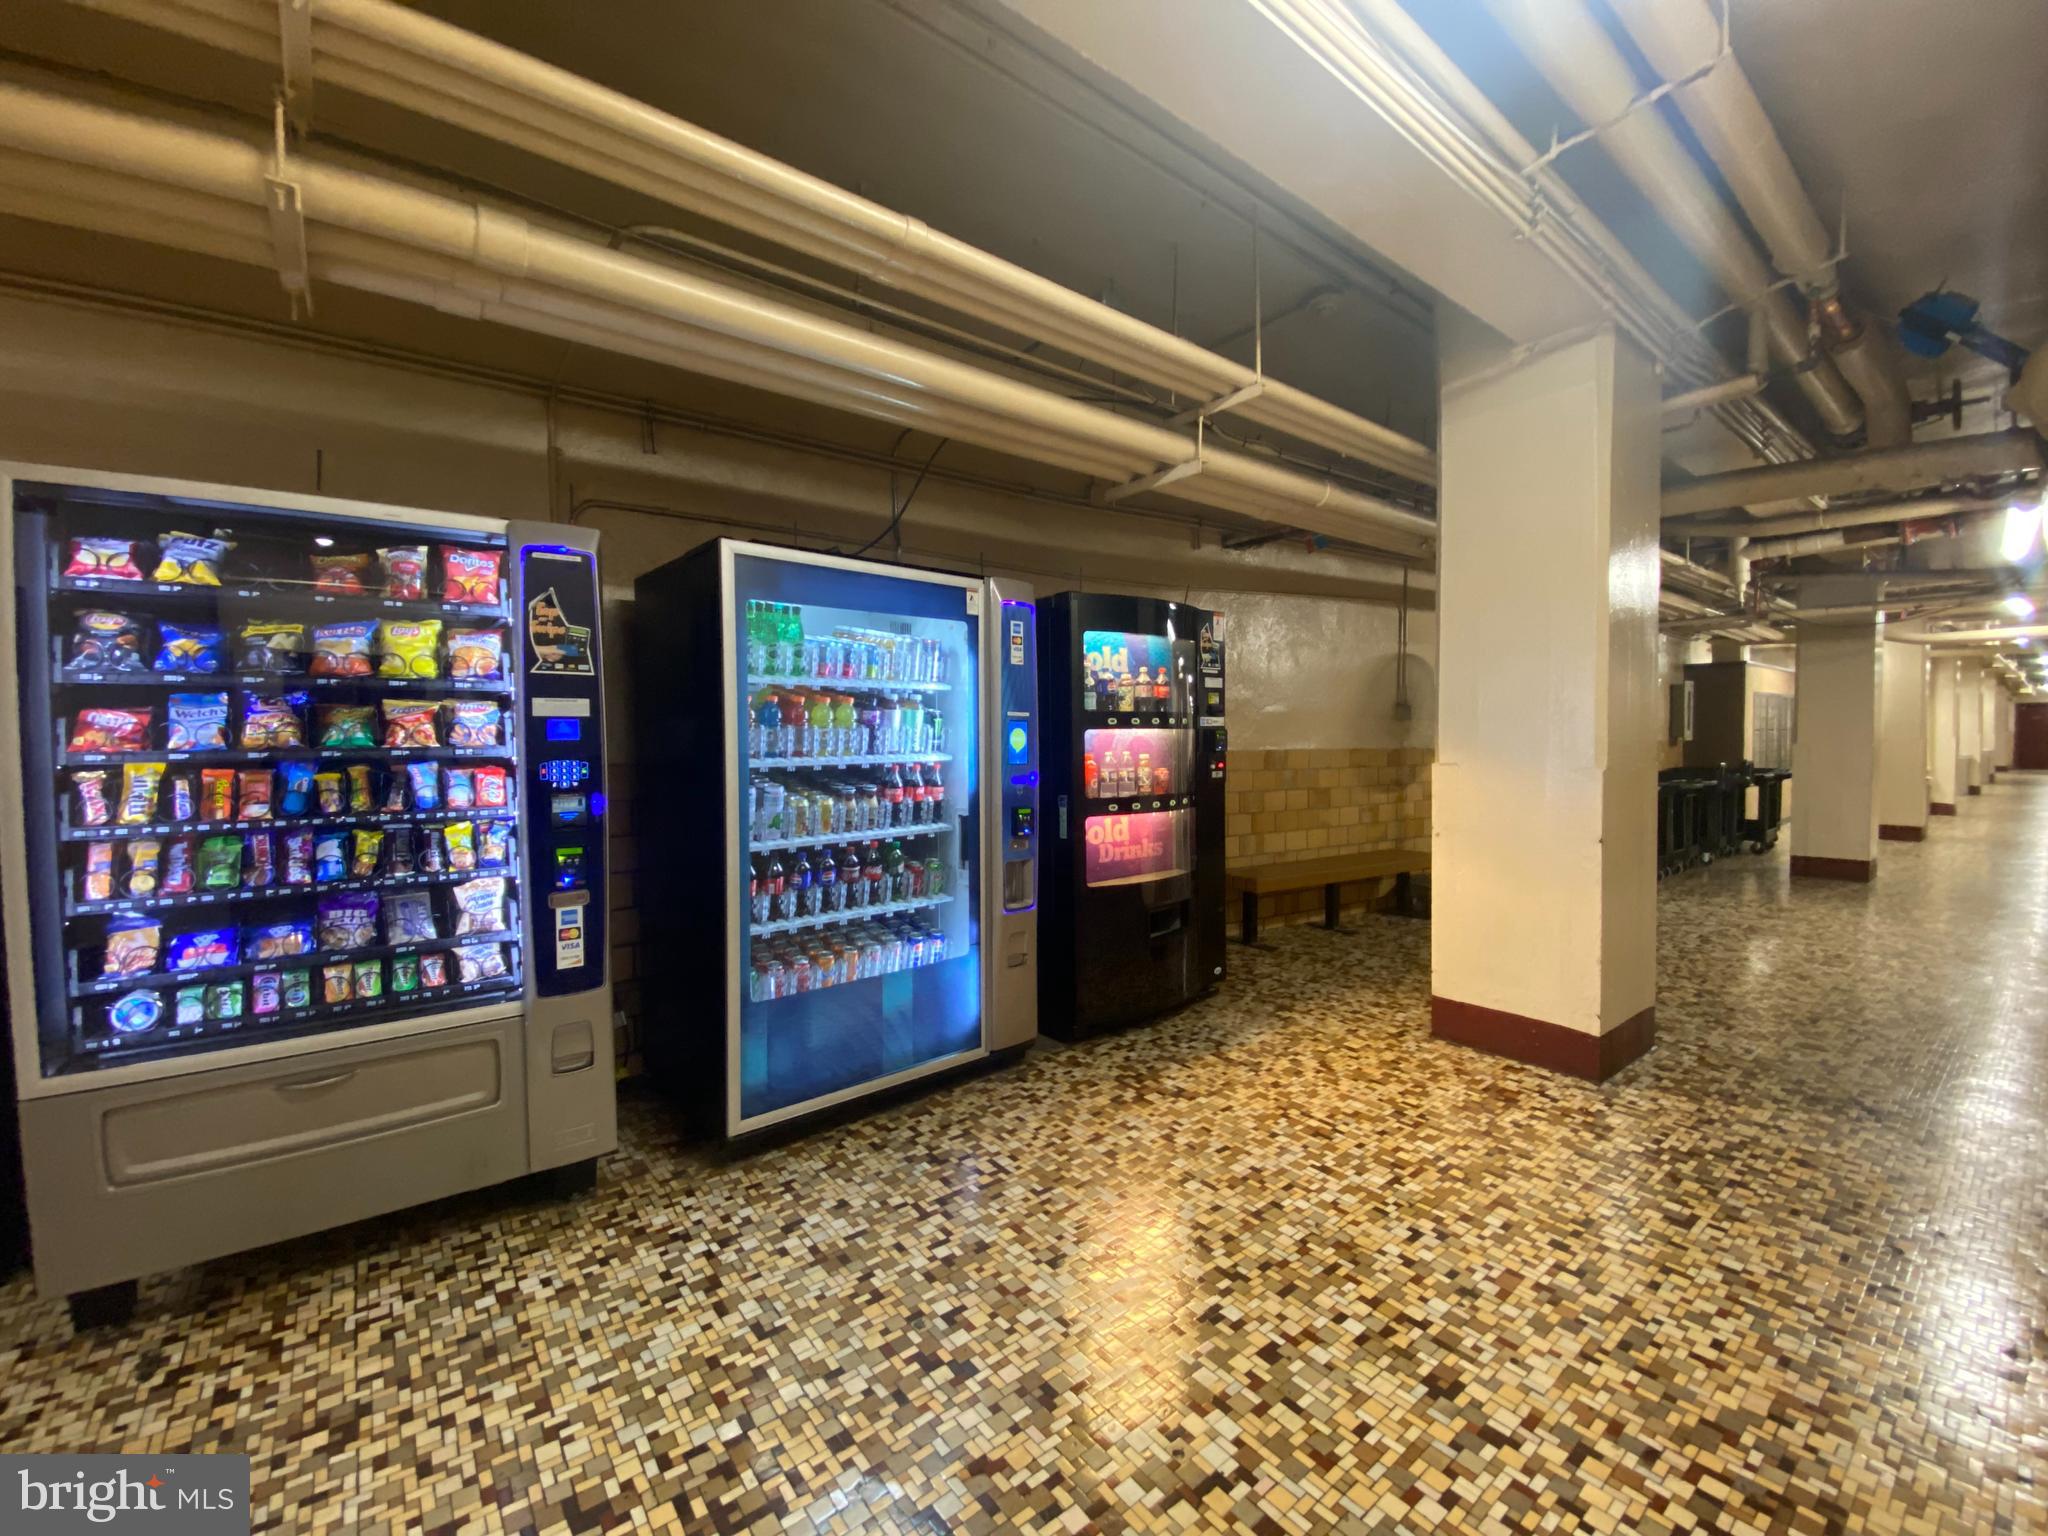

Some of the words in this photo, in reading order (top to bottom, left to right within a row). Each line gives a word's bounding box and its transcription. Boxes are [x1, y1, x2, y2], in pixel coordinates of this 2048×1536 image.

[449, 554, 495, 571] Doritos
[1088, 645, 1129, 673] old
[175, 708, 227, 718] Welch's
[1088, 816, 1129, 845] old
[1098, 838, 1164, 863] Drinks
[328, 909, 369, 919] BIG
[561, 942, 580, 950] VISA
